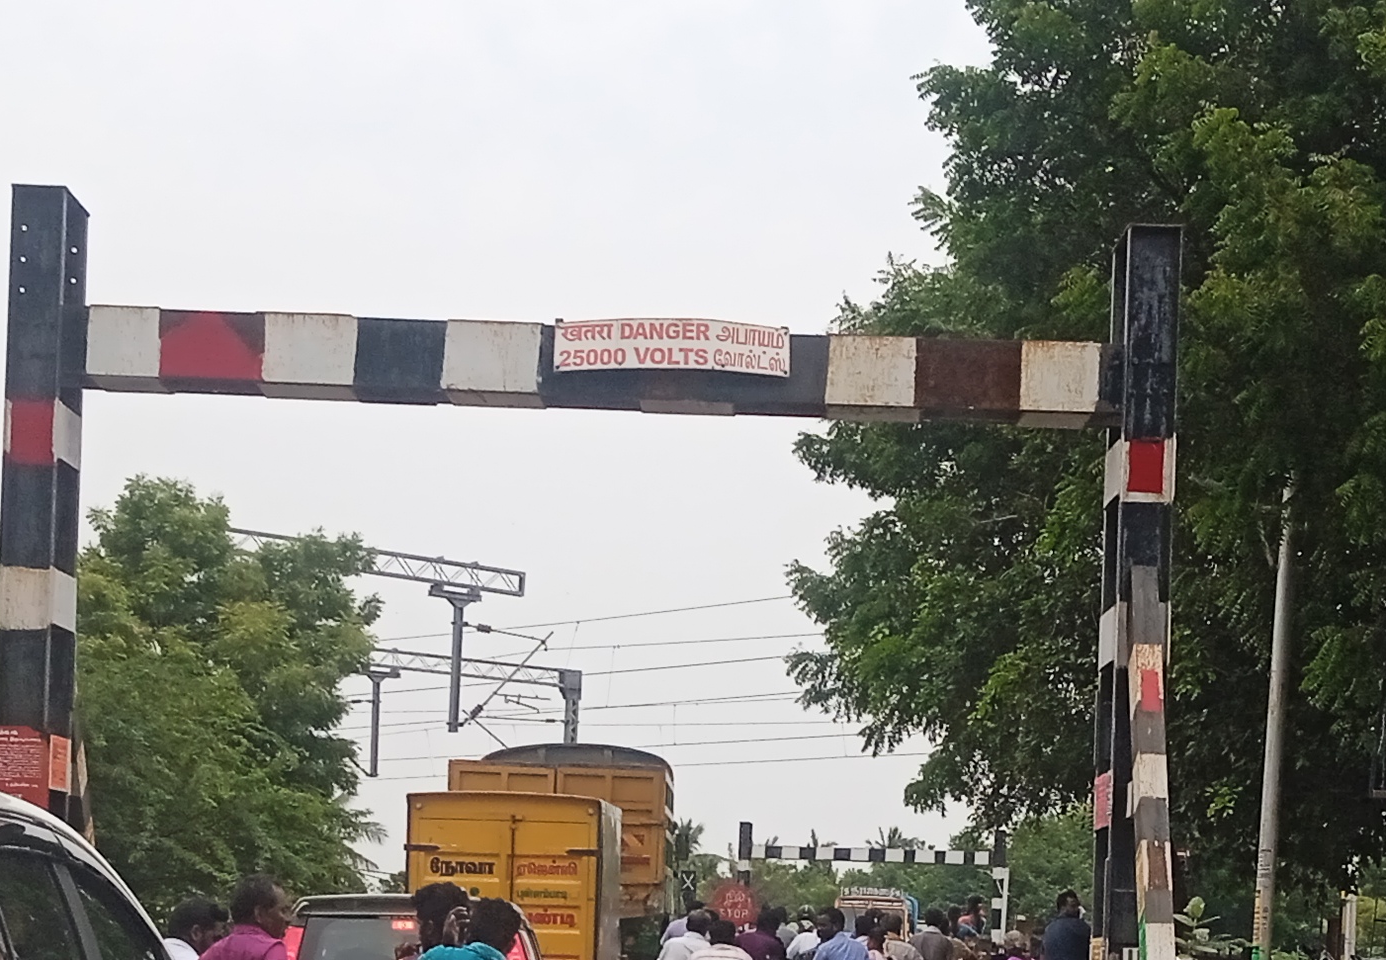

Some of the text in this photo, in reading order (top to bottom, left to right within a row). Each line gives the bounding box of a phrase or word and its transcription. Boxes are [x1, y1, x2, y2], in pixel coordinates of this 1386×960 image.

[562, 323, 614, 343] खतरा
[620, 322, 710, 341] DANGER
[559, 347, 786, 372] 25000 VOLTS வோல்ட்ஸ்
[430, 857, 495, 877] நோவா
[720, 908, 749, 918] STOP
